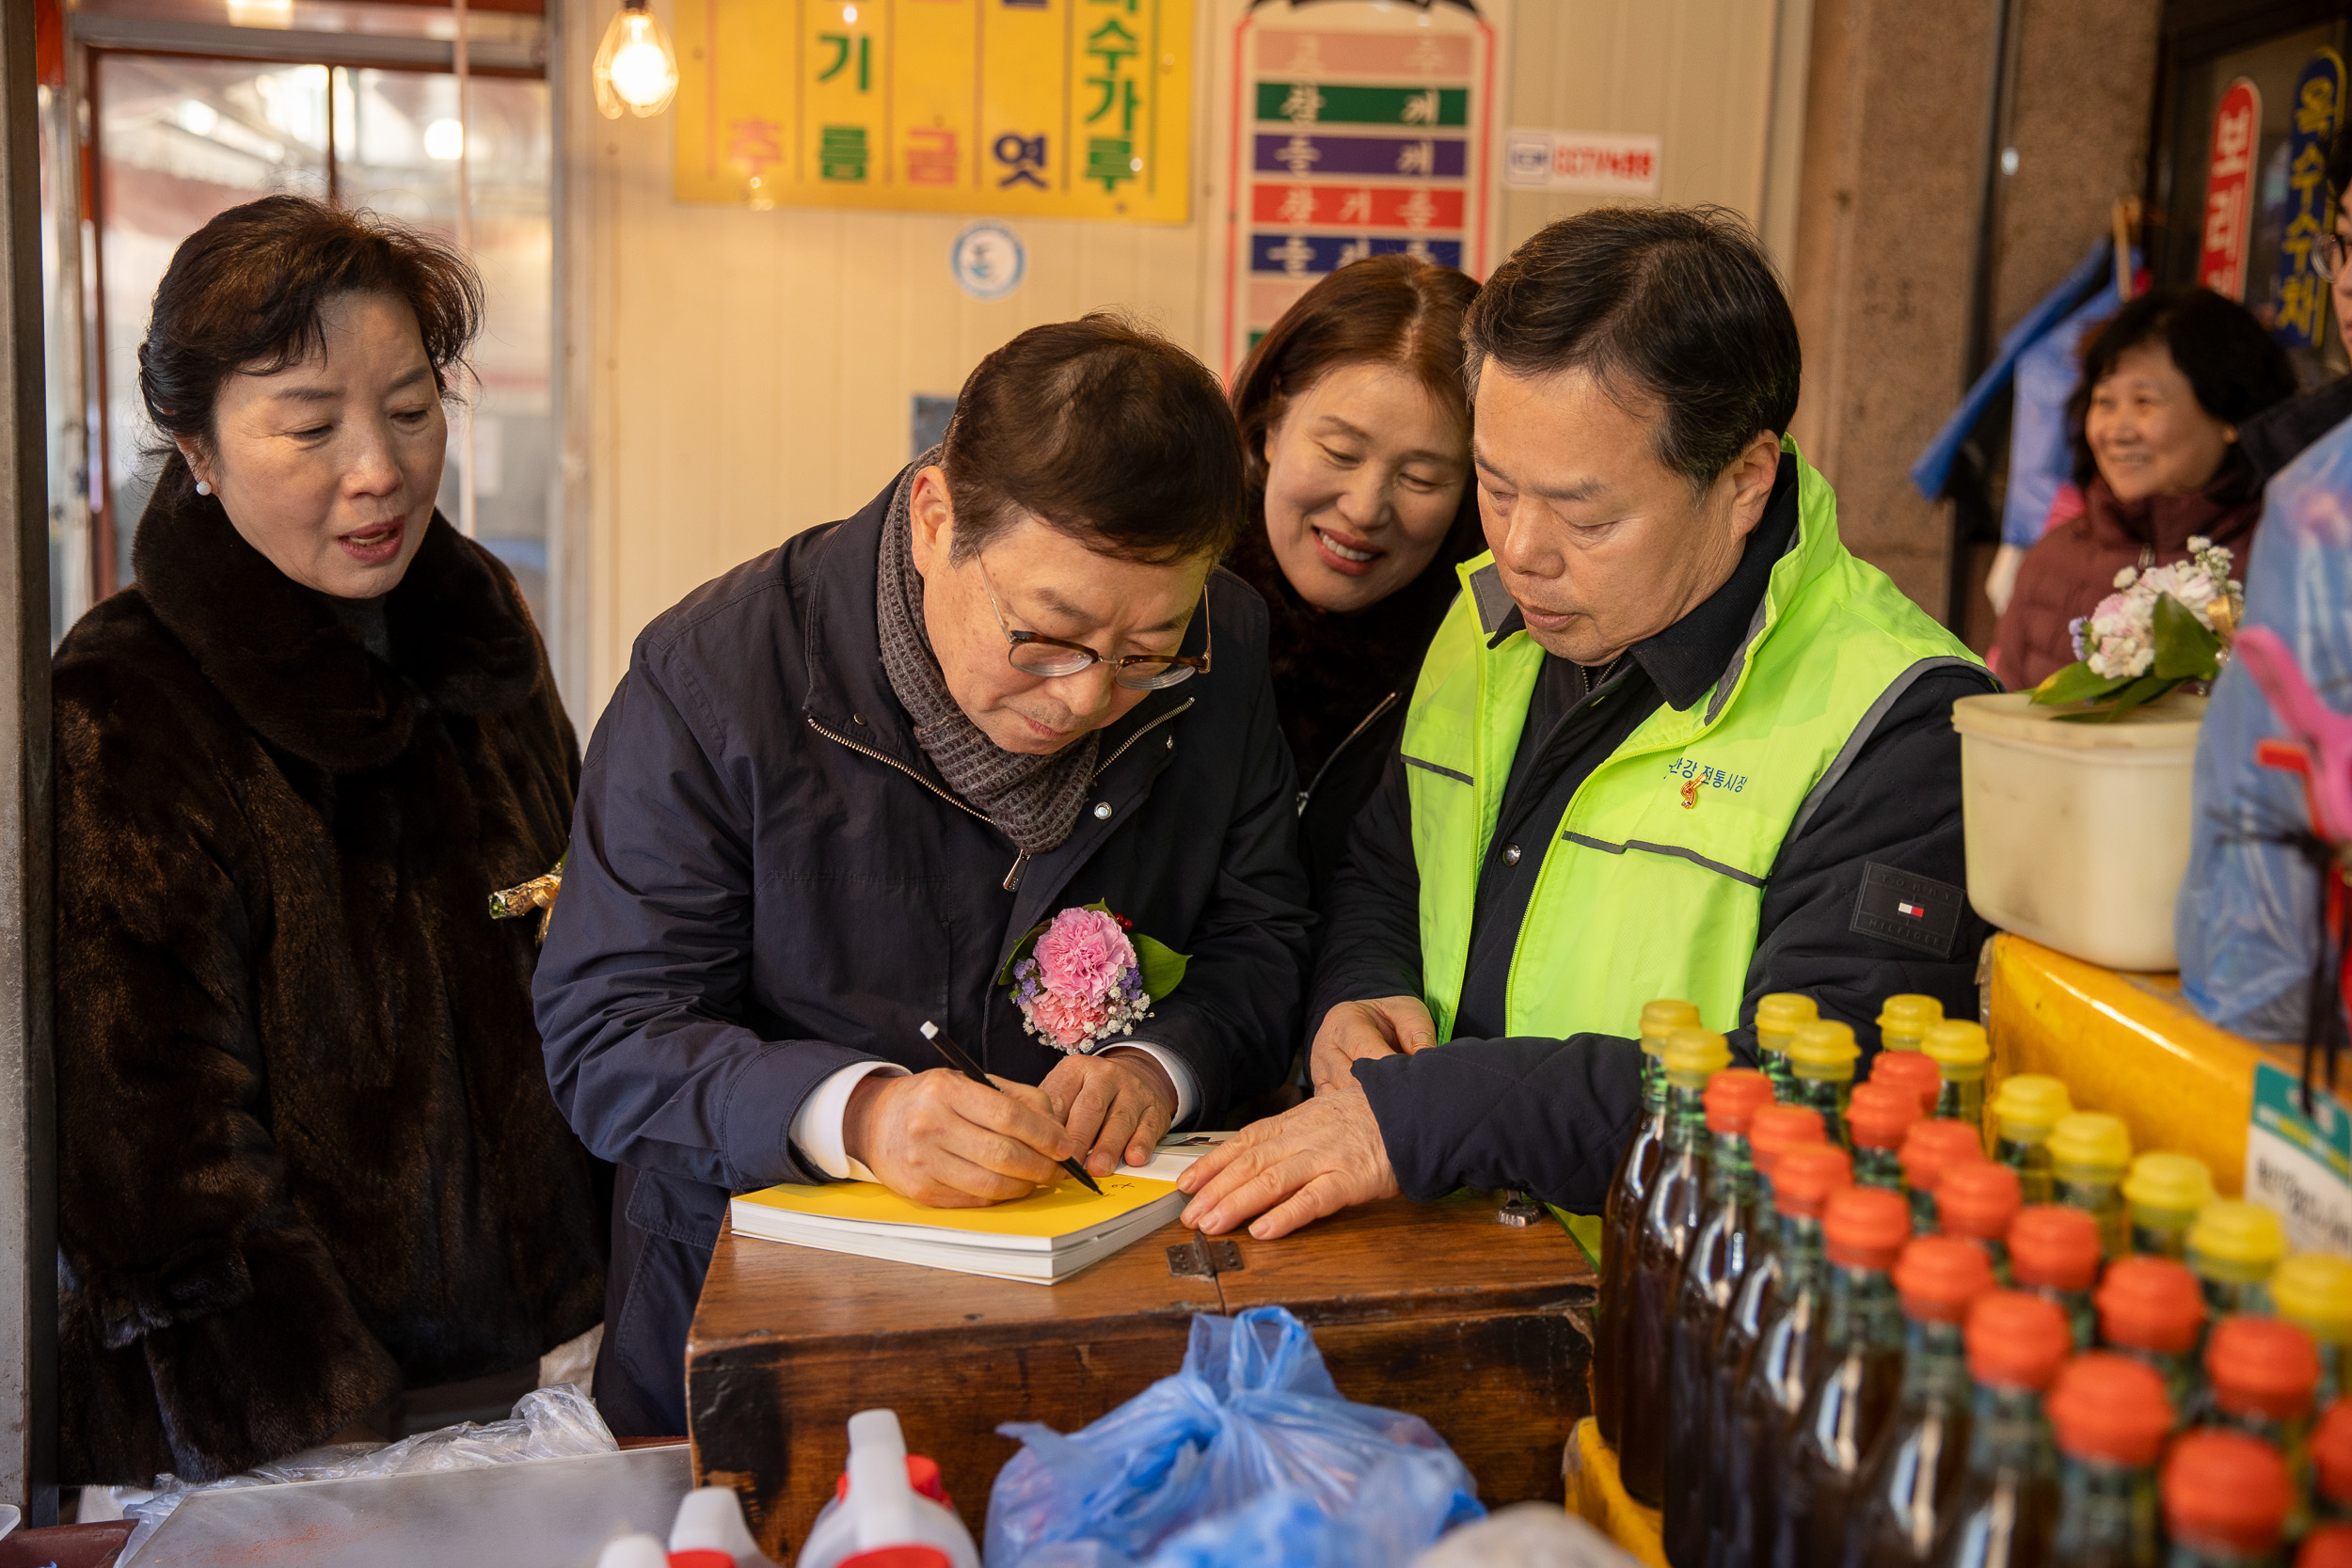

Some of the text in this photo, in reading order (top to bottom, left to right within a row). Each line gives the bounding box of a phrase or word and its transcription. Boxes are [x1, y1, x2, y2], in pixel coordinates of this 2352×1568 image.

[817, 0, 871, 182] 기름
[1085, 0, 1141, 194] 수가루
[1700, 765, 1749, 793] 전통시장
[1881, 874, 1951, 901] TOMMY
[1868, 918, 1940, 946] HILFIGER
